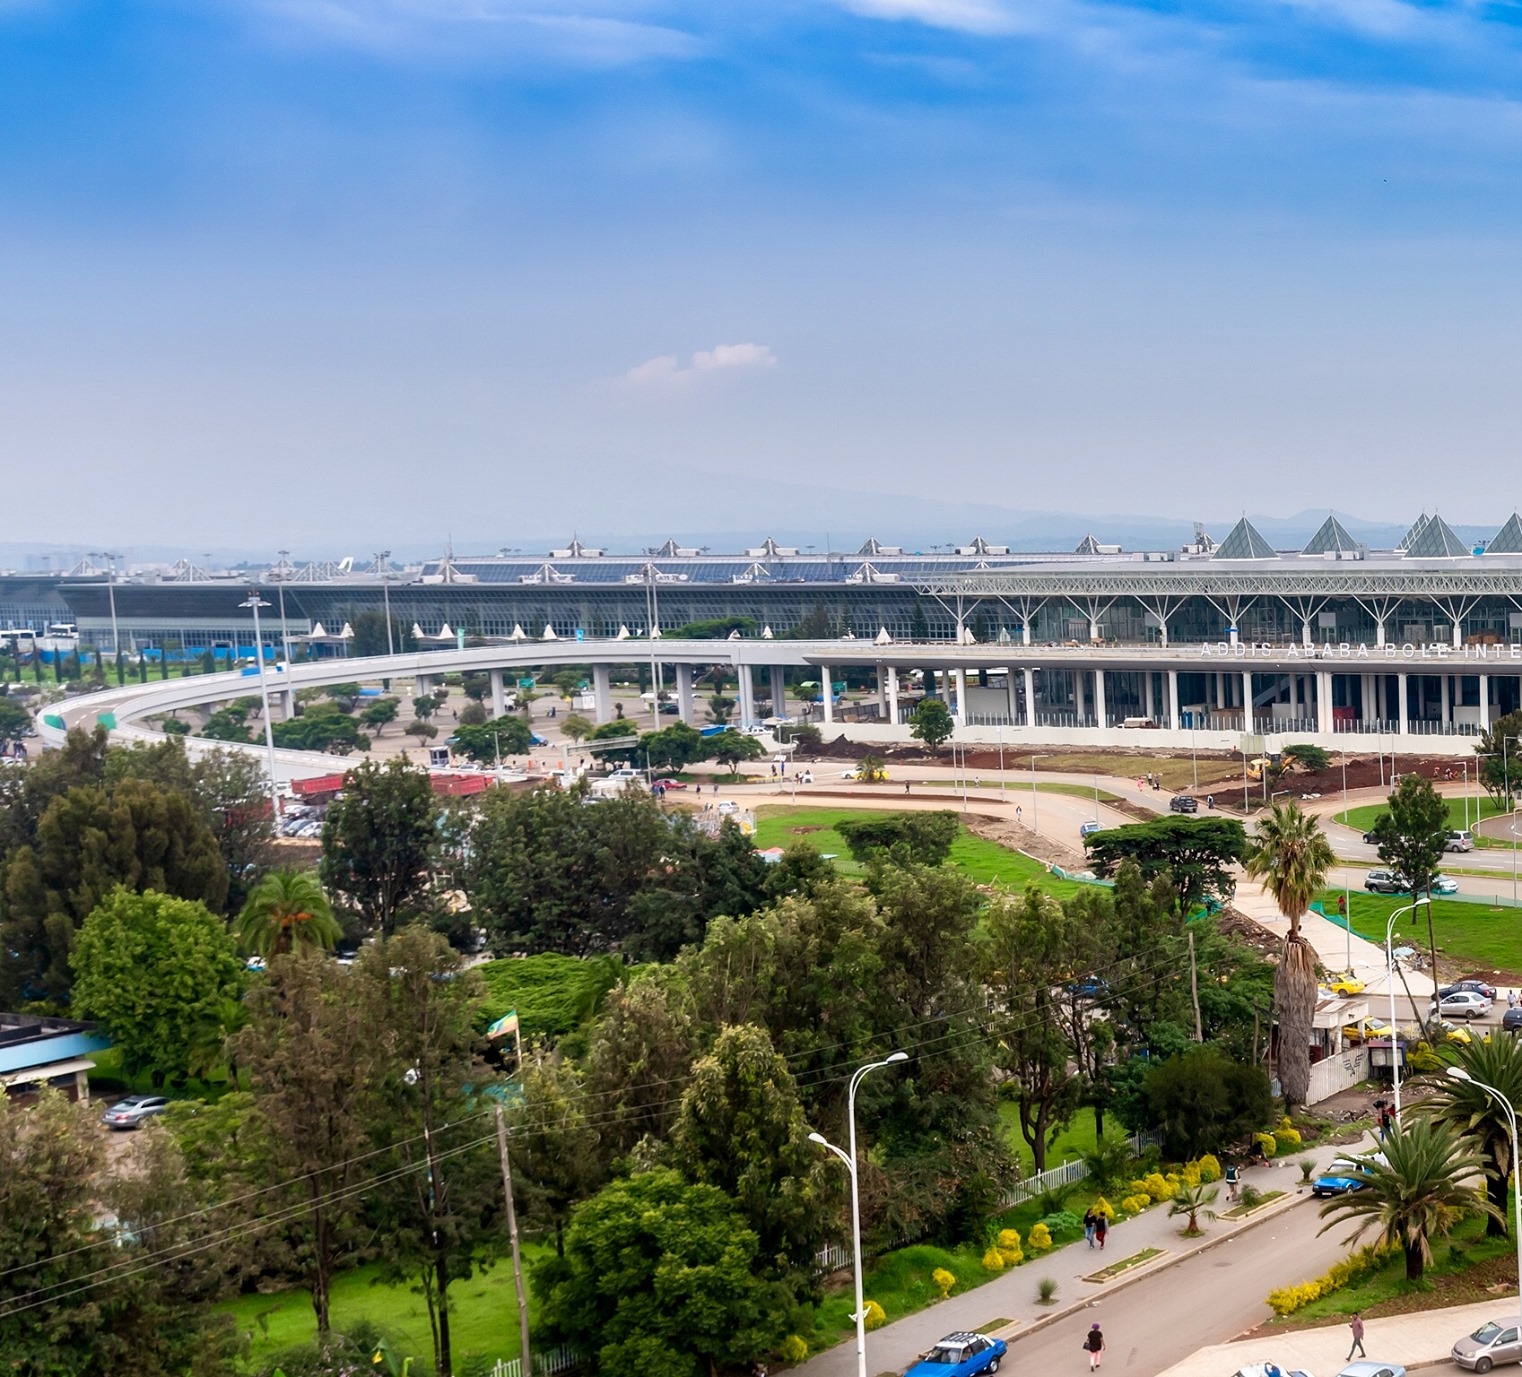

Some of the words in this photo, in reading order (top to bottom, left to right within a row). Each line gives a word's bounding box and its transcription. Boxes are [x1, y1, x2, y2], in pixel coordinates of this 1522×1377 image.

[1200, 642, 1272, 656] ADDIS
[1287, 642, 1369, 657] ABABA
[1384, 643, 1448, 658] BOLE
